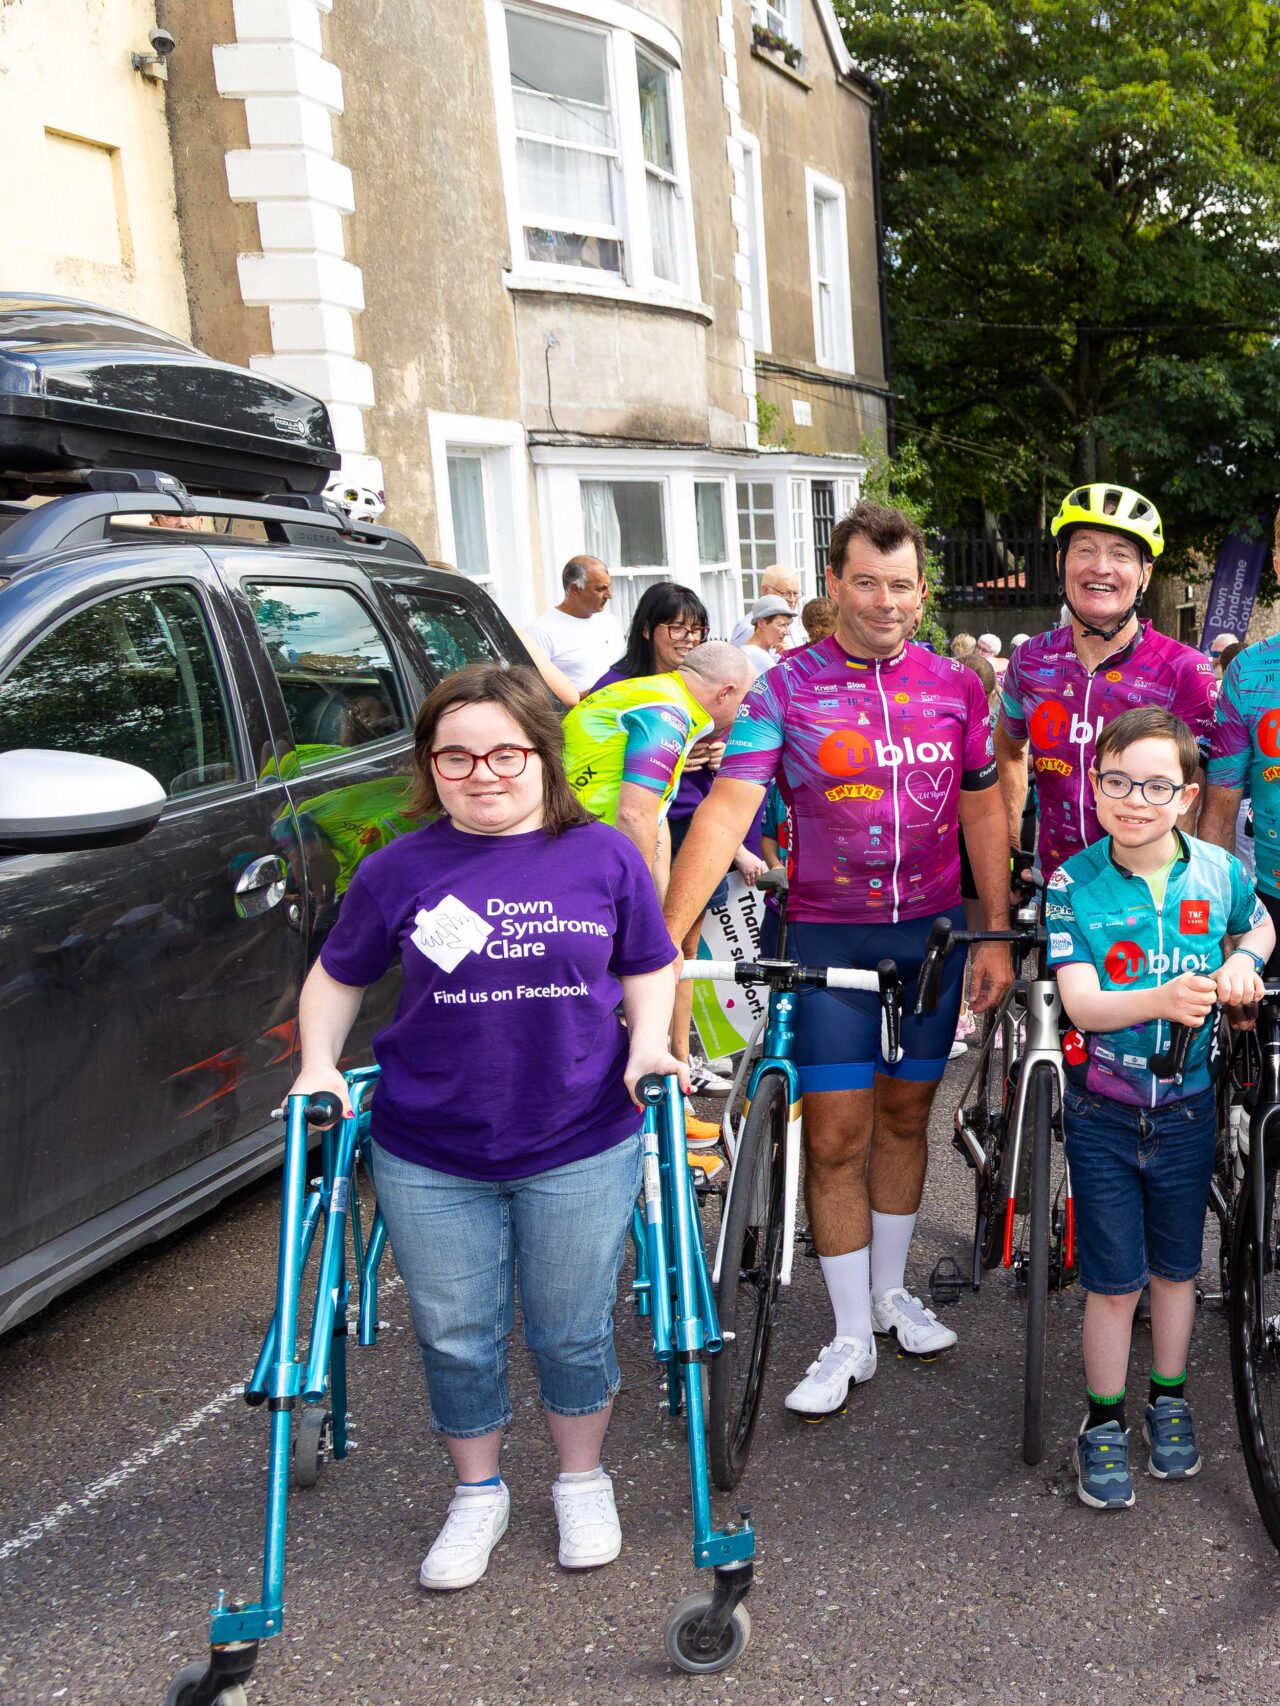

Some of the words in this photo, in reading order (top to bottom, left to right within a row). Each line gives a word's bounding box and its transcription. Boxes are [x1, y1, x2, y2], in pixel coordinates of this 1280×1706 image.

[300, 532, 337, 543] DUSTER
[1222, 559, 1247, 630] Syndrome
[1209, 587, 1229, 627] Down
[1236, 596, 1254, 632] Cork
[814, 684, 838, 692] Kneat
[1036, 757, 1073, 777] SMYTHS
[827, 785, 883, 801] SMYTHS
[486, 898, 554, 916] Down
[1187, 910, 1204, 919] TMF
[500, 917, 609, 941] Syndrome
[710, 902, 740, 943] your
[485, 939, 546, 960] Clare
[433, 990, 467, 1004] Find
[470, 989, 489, 1003] us
[491, 988, 513, 1001] on
[516, 982, 590, 1000] Facebook
[721, 1542, 732, 1556] 2
